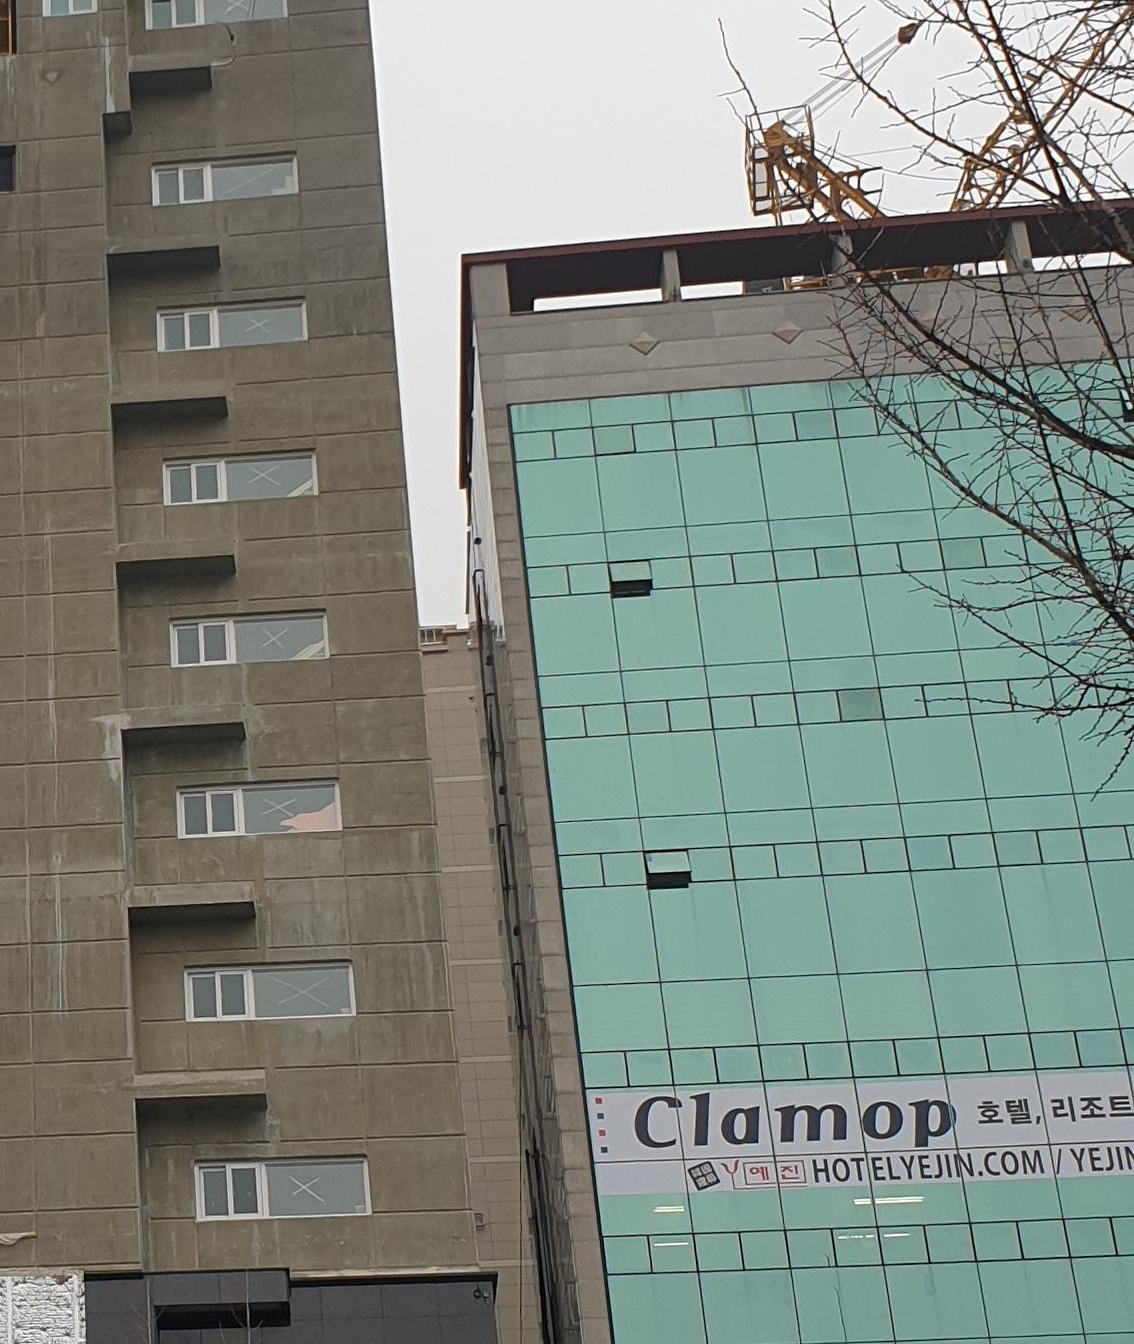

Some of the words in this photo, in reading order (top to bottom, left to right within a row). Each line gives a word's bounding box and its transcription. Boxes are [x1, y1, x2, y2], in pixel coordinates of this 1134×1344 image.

[634, 1092, 957, 1149] Clamop
[977, 1098, 1041, 1126] 호텔,
[1050, 1095, 1134, 1123] 리조트
[812, 1150, 1045, 1184] HOTELYEJIN.COM
